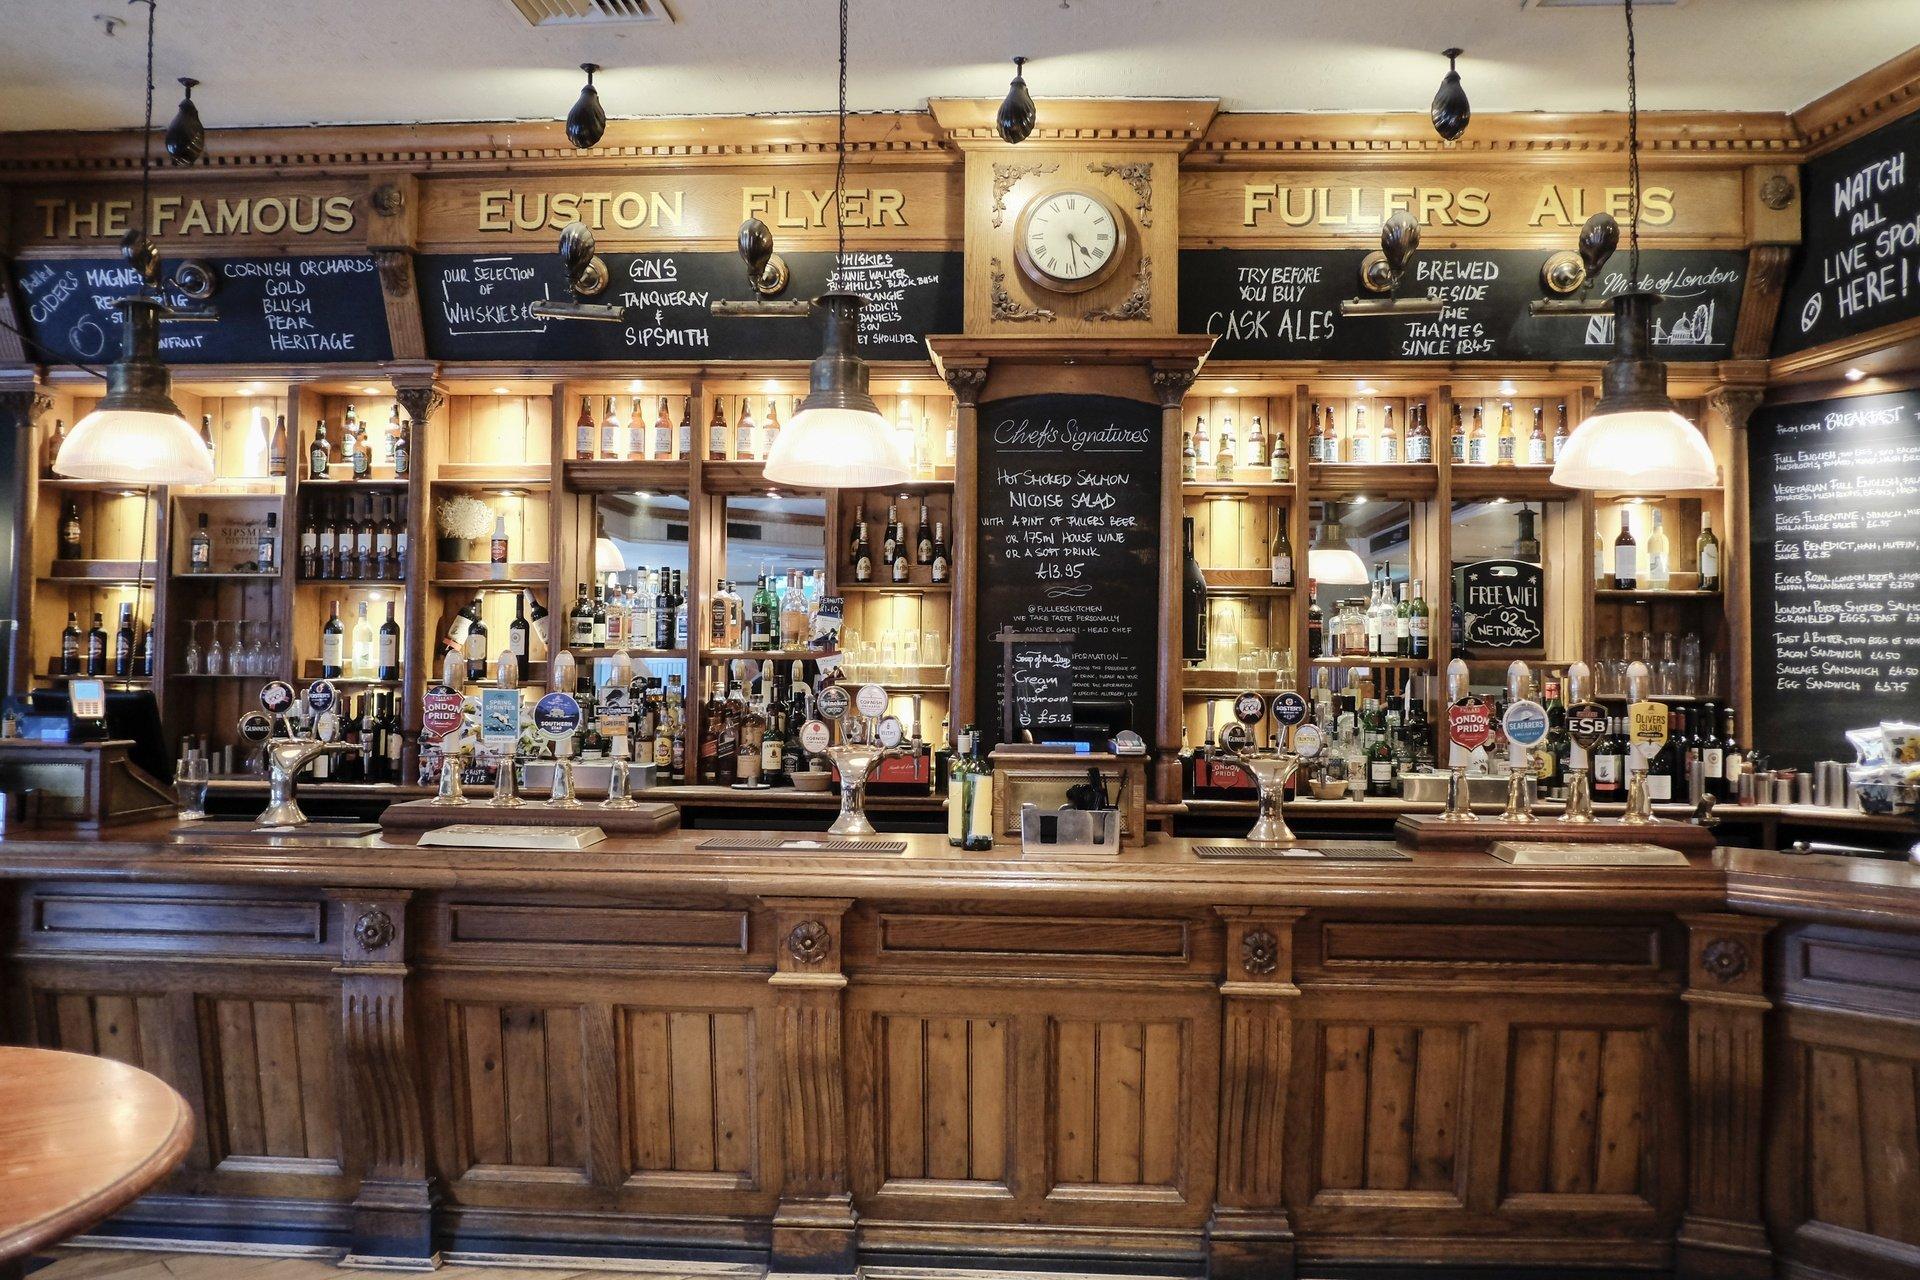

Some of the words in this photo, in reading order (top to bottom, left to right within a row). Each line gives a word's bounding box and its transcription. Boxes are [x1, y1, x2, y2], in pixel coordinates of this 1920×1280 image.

[1834, 152, 1905, 217] WATCH
[477, 189, 687, 232] EUSTON
[742, 186, 908, 228] FLYER
[1243, 183, 1492, 227] FULLERS
[1528, 184, 1675, 227] ALES
[38, 198, 133, 237] THE
[150, 196, 356, 235] FAMOUS
[1851, 202, 1886, 236] ALL
[225, 262, 291, 278] CORNISH
[300, 260, 374, 276] ORCHARDS
[630, 259, 677, 279] GINS
[1416, 260, 1499, 281] BREWED
[1824, 242, 1867, 284] LIVE
[444, 268, 470, 283] OUR
[474, 267, 534, 281] SELECTION
[869, 268, 909, 281] WALKER
[887, 279, 917, 289] BLACK
[917, 274, 940, 285] BUSH
[1237, 266, 1270, 284] TRY
[1272, 266, 1323, 284] BEFORE
[1673, 267, 1739, 288] London
[265, 280, 306, 295] GOLD
[479, 283, 495, 295] OF
[1239, 285, 1271, 301] YOU
[1273, 284, 1305, 301] BUY
[1427, 285, 1489, 301] BESIDE
[1838, 258, 1908, 318] HERE!
[30, 270, 80, 323] CIDERS
[619, 290, 709, 309] TANQUERAY
[263, 299, 311, 314] BLUSH
[443, 301, 519, 324] WHISKIES
[1439, 305, 1469, 321] THE
[265, 315, 314, 330] PEAR
[654, 309, 664, 325] &
[1207, 310, 1270, 341] CASK
[1278, 309, 1336, 341] ALES
[625, 327, 709, 348] SIPSMITH
[872, 333, 918, 343] SHOULDER
[1404, 322, 1484, 339] THAMES
[270, 333, 355, 350] HERITAGE
[1401, 340, 1450, 356] SINCE
[1456, 339, 1495, 354] 1845
[1824, 406, 1904, 431] BREAKFAST
[994, 419, 1058, 448] Chef's
[1061, 418, 1150, 451] Signatures
[997, 467, 1022, 486] HOT
[1023, 470, 1072, 487] SMOKED
[1076, 470, 1129, 486] SALMON
[1774, 483, 1827, 495] VEGETARIAN
[1010, 491, 1063, 508] NICOISE
[1071, 492, 1116, 510] SALAD
[981, 517, 1004, 526] WITH
[1050, 516, 1061, 526] OF
[1109, 516, 1138, 526] BEER
[1775, 513, 1801, 525] EGGS
[1006, 534, 1019, 544] OR
[1023, 531, 1055, 545] 175ml
[1062, 532, 1093, 544] HOUSE
[1098, 532, 1125, 543] WINE
[1774, 540, 1799, 552] EGGS
[1006, 550, 1020, 559] OR
[1024, 549, 1033, 558] A
[1034, 548, 1060, 557] SOFT
[1065, 547, 1101, 557] DRINK
[1035, 563, 1085, 579] £13.95
[1775, 573, 1802, 584] EGGS
[1470, 586, 1502, 604] FREE
[1506, 586, 1537, 607] WIFI
[1775, 601, 1811, 614] LONDON
[1814, 600, 1844, 613] PORTER
[1844, 600, 1883, 613] SMOKED
[1076, 614, 1120, 623] PERSONALLY
[1775, 614, 1835, 623] SCRAMBLED
[1871, 614, 1897, 622] TOAST
[1478, 624, 1532, 638] NETWORK
[1772, 632, 1800, 644] TOAST
[1776, 648, 1808, 658] BACON
[1810, 646, 1862, 659] SANDWICH
[1776, 663, 1819, 674] SAUSAGE
[1821, 662, 1879, 675] SANDWICH
[1014, 670, 1058, 688] Cream
[1777, 678, 1801, 689] EGG
[1805, 677, 1861, 690] SANDWICH
[423, 703, 461, 713] LONDON
[1016, 696, 1069, 704] mushroom
[428, 712, 456, 720] PRIDE
[1037, 709, 1072, 724] £5.25
[1450, 714, 1489, 726] LONDON
[1457, 724, 1484, 732] PRIDE
[1509, 720, 1544, 730] SEAFARERS
[1569, 718, 1606, 734] ESB
[1640, 723, 1662, 732] ISLAND
